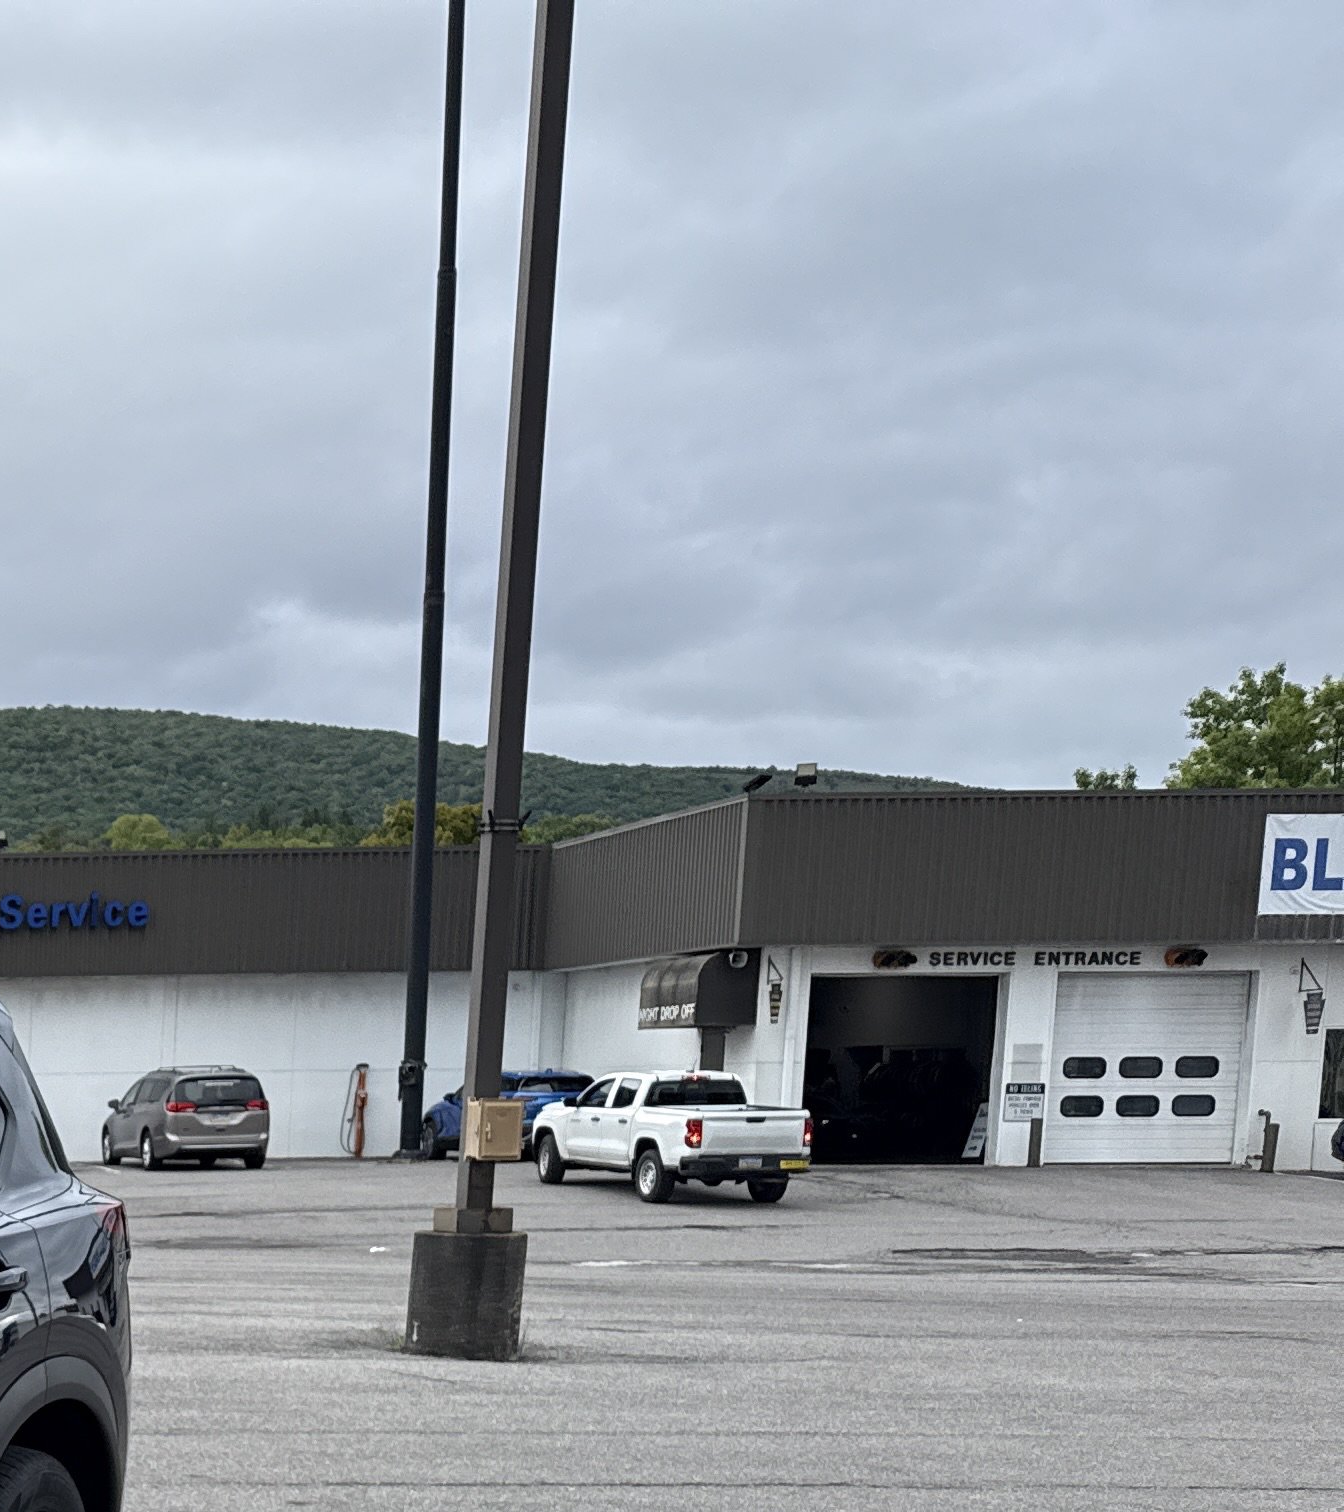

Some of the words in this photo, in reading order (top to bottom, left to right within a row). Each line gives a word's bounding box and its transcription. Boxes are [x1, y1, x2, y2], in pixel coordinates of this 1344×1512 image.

[1271, 838, 1343, 890] BL
[0, 891, 149, 929] Service
[929, 951, 1017, 966] SERVICE
[1033, 951, 1142, 966] ENTRANCE
[660, 1004, 679, 1021] DROP
